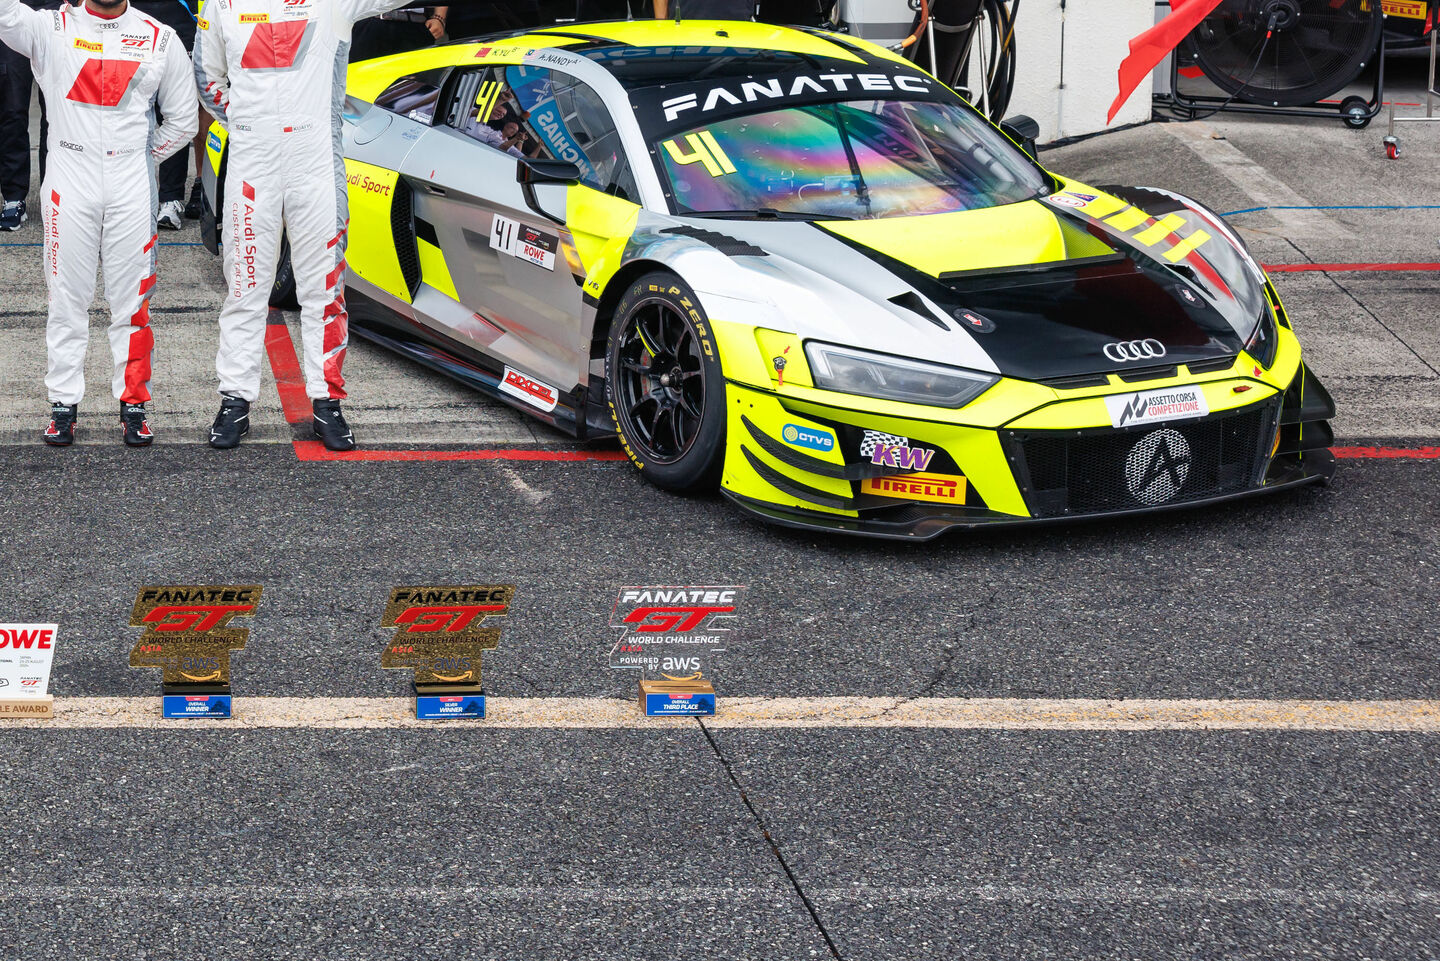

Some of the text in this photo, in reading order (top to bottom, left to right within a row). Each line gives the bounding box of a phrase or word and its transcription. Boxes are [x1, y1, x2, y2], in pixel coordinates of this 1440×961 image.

[475, 80, 504, 123] 41
[662, 73, 931, 123] FANATEC
[60, 140, 83, 152] sparco
[663, 129, 738, 178] 41
[361, 176, 390, 197] Sport
[51, 208, 59, 238] Audi
[232, 202, 240, 259] customer
[495, 218, 512, 250] 41
[243, 203, 257, 289] Audi Sport
[523, 245, 545, 261] ROWE
[680, 296, 714, 358] ZERO
[1148, 392, 1197, 407] ASSETTO CORSA
[1148, 401, 1199, 417] COMPETIZIONE
[871, 442, 936, 472] KW
[871, 474, 958, 498] PIRELLI
[142, 591, 252, 602] FANATEC
[394, 591, 506, 603] FANATEC
[622, 591, 736, 603] FANATEC
[628, 636, 663, 644] WORLD
[182, 657, 219, 670] aws
[434, 657, 471, 671] aws
[663, 657, 700, 670] aws
[12, 705, 49, 713] AWARD
